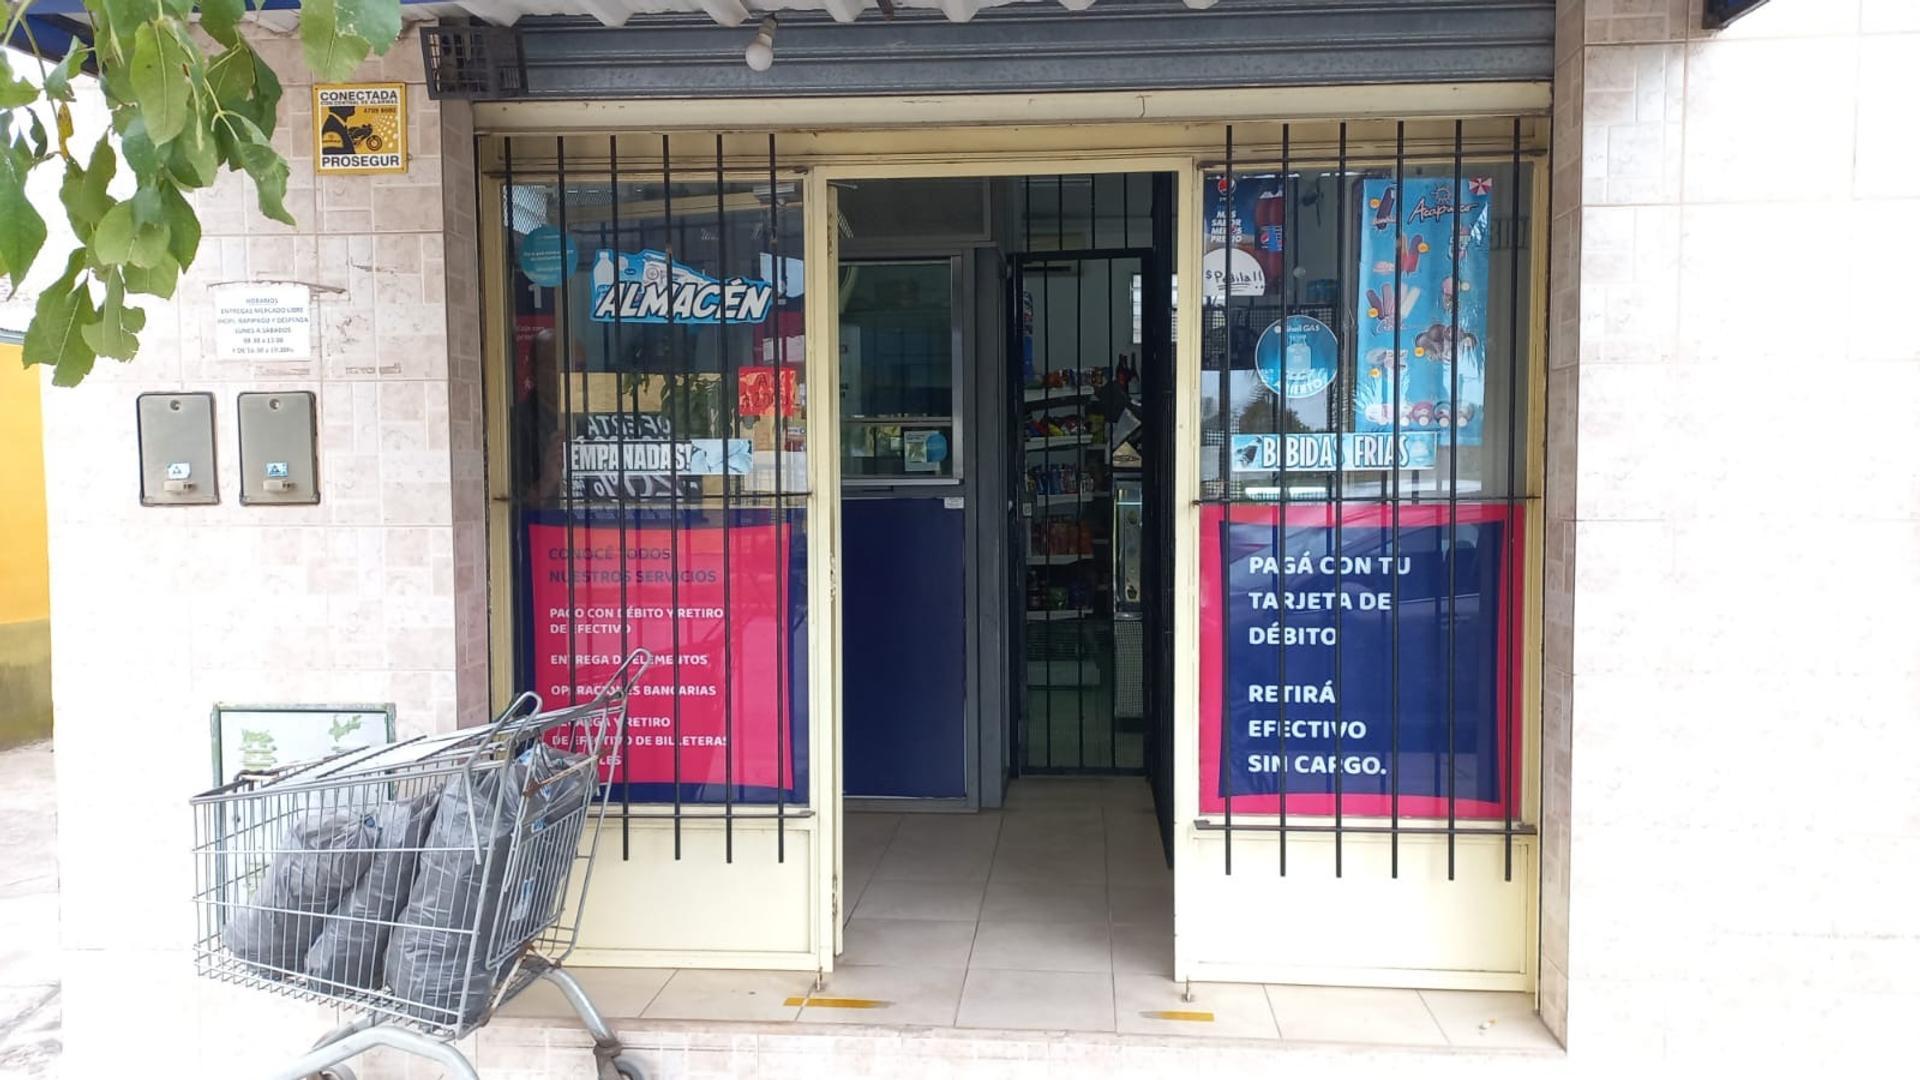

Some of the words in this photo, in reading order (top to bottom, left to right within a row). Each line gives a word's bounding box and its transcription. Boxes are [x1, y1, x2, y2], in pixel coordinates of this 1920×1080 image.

[320, 90, 398, 101] CONECTADA
[321, 156, 400, 167] PROSEGUR
[1217, 210, 1237, 219] MS
[1407, 198, 1479, 225] Acapuco
[595, 278, 772, 320] ALMACÉN
[1354, 434, 1410, 467] FRIAS
[1248, 551, 1314, 575] PAGÁ
[1319, 556, 1371, 575] CON
[1378, 556, 1412, 575] TU
[636, 570, 717, 583] SERVCIOS
[1248, 591, 1354, 611] TARJETA
[1359, 592, 1393, 611] DE
[587, 608, 614, 618] CON
[666, 608, 674, 618] Y
[677, 608, 724, 618] RETIRO
[550, 623, 567, 634] DE
[1248, 621, 1338, 646] DÉBITO
[551, 654, 610, 665] ENREGA
[1248, 679, 1337, 704] RETIRÁ
[626, 717, 671, 728] RETIRO
[1248, 719, 1368, 740] EFECTIVO
[552, 735, 569, 746] DE
[635, 735, 652, 746] DE
[1247, 754, 1289, 773] SIN
[1294, 755, 1388, 776] CARGO.
